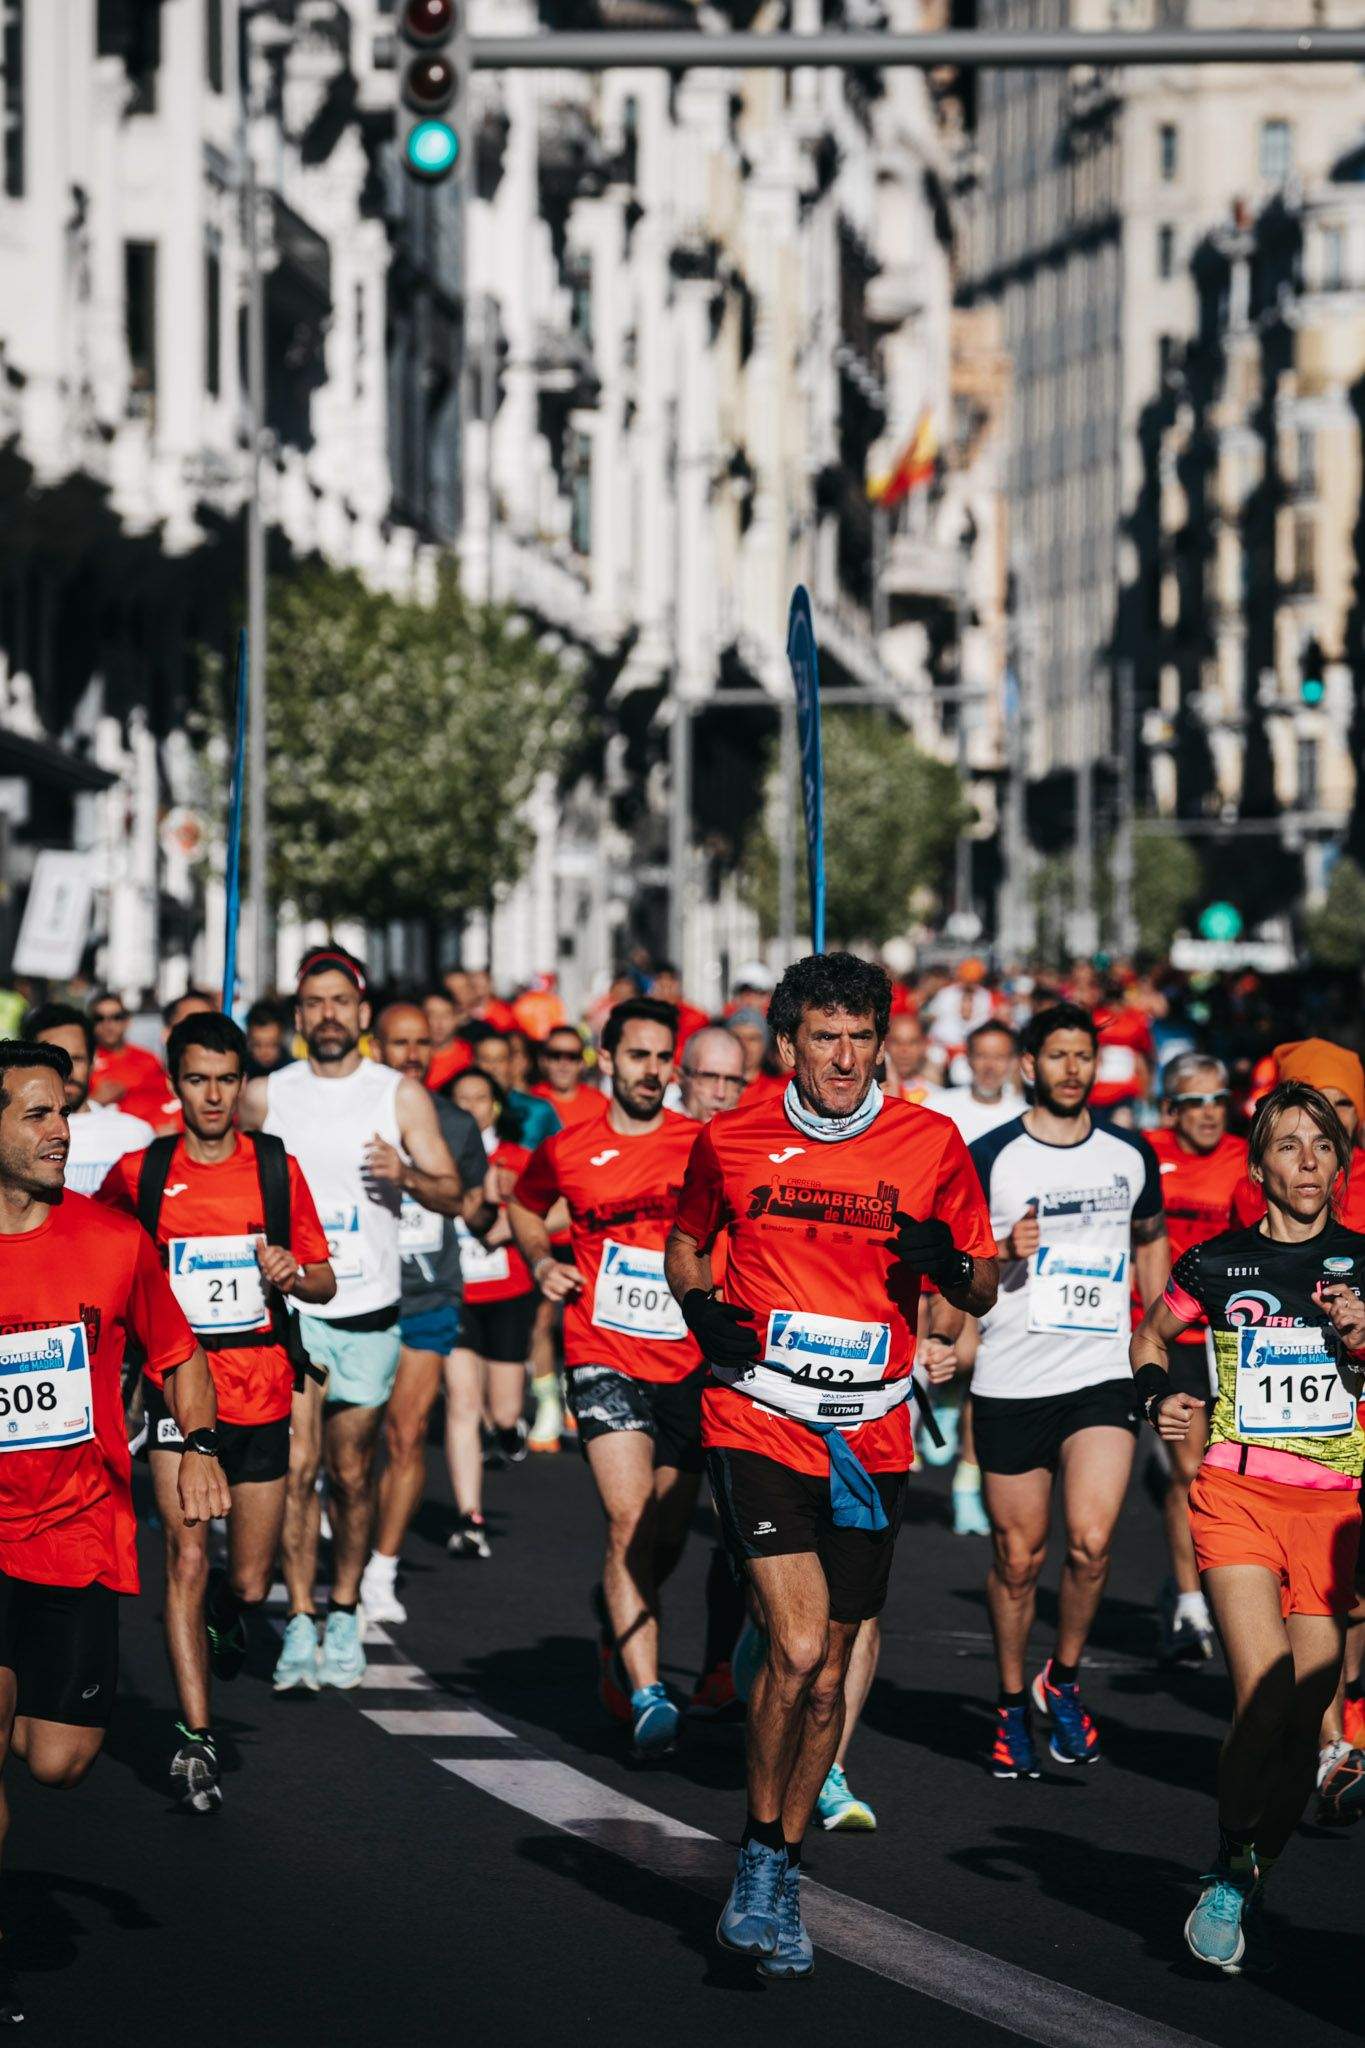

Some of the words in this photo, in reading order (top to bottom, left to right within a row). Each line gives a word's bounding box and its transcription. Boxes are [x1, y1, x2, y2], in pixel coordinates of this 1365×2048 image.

[786, 1177, 822, 1188] CARRERA
[785, 1187, 893, 1214] BOMBEROS
[825, 1208, 840, 1221] de
[843, 1208, 892, 1230] MADRID
[208, 1278, 238, 1302] 21
[615, 1283, 673, 1312] 1607
[1059, 1284, 1102, 1308] 196
[806, 1333, 869, 1350] BOMBEROS
[829, 1346, 839, 1356] de
[19, 1363, 30, 1372] de
[1298, 1354, 1307, 1363] de
[1259, 1373, 1338, 1404] 1167
[820, 1405, 833, 1414] BY
[833, 1405, 861, 1414] UTMB
